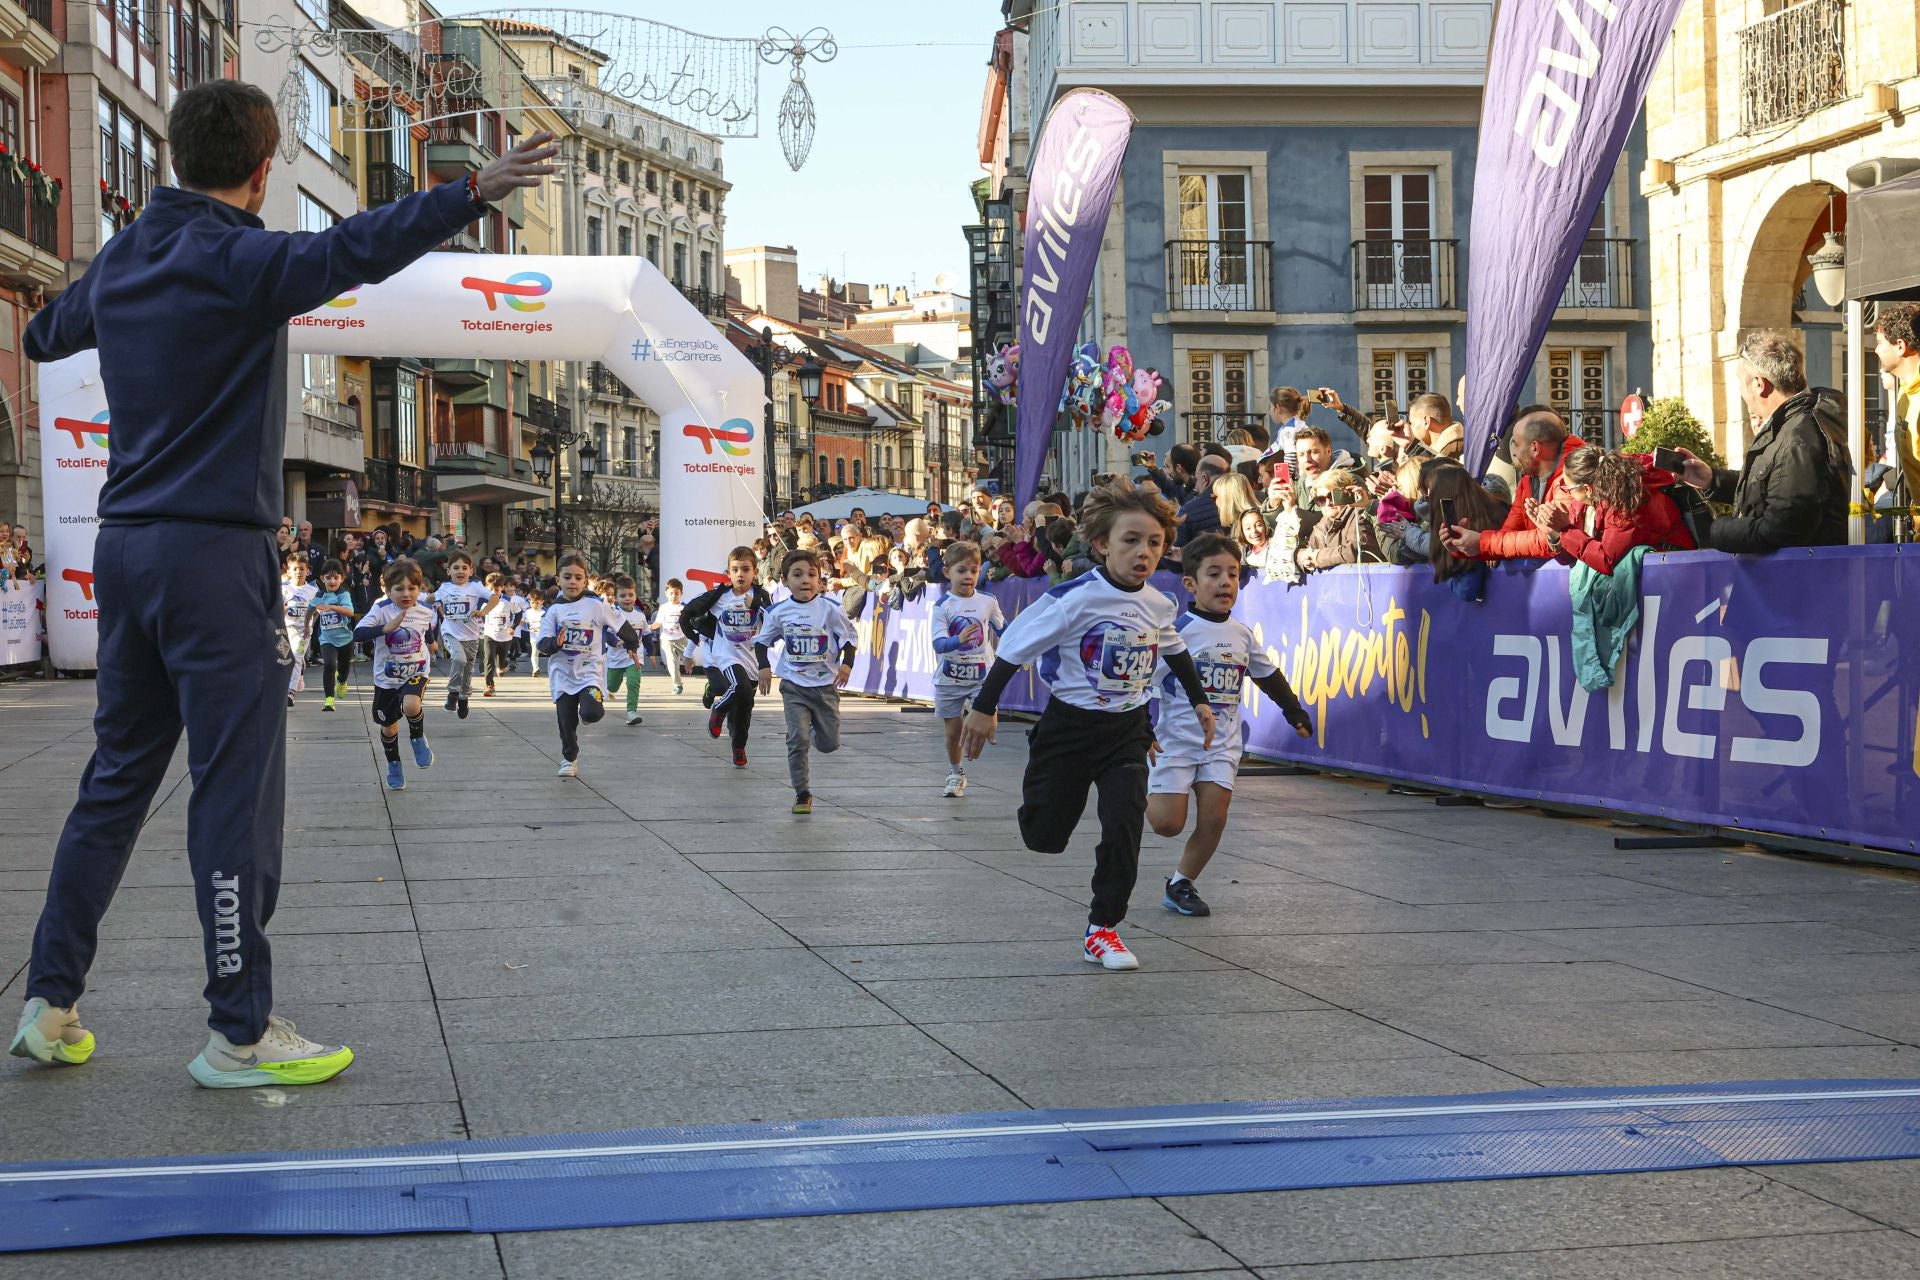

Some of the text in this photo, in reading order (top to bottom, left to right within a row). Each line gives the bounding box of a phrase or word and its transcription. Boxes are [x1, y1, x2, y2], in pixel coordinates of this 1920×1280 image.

[288, 315, 365, 330] talEnergies
[461, 319, 553, 333] TotalEnergies
[56, 458, 108, 468] TotalEne
[683, 463, 755, 476] TotalEnergies
[684, 518, 755, 528] totalenergies.es
[446, 603, 466, 615] 3670
[727, 611, 751, 624] 3158
[792, 637, 819, 653] 3116
[1113, 650, 1154, 676] 3292
[950, 663, 979, 679] 3291
[1200, 666, 1240, 690] 3662
[1485, 595, 1829, 767] avilés
